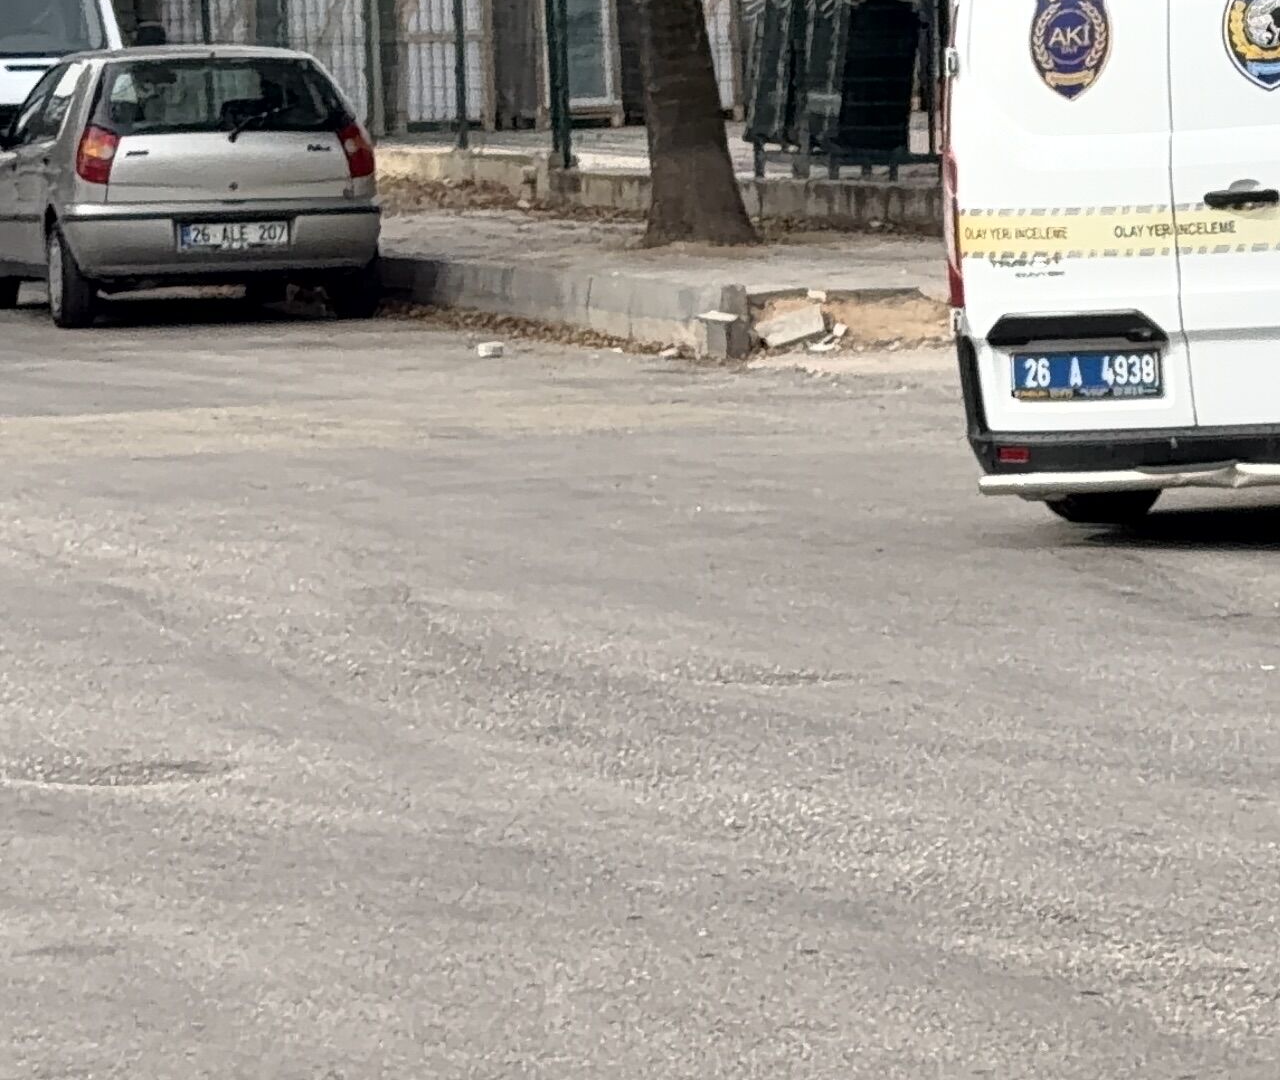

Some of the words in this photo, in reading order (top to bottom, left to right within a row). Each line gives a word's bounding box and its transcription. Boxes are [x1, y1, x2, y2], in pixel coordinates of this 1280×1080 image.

[192, 225, 211, 243] 26
[258, 224, 286, 241] 207
[964, 226, 987, 240] OLAY
[1114, 223, 1144, 238] OLAY
[1024, 357, 1051, 388] 26
[1069, 356, 1083, 388] A
[1101, 353, 1155, 387] 4938
